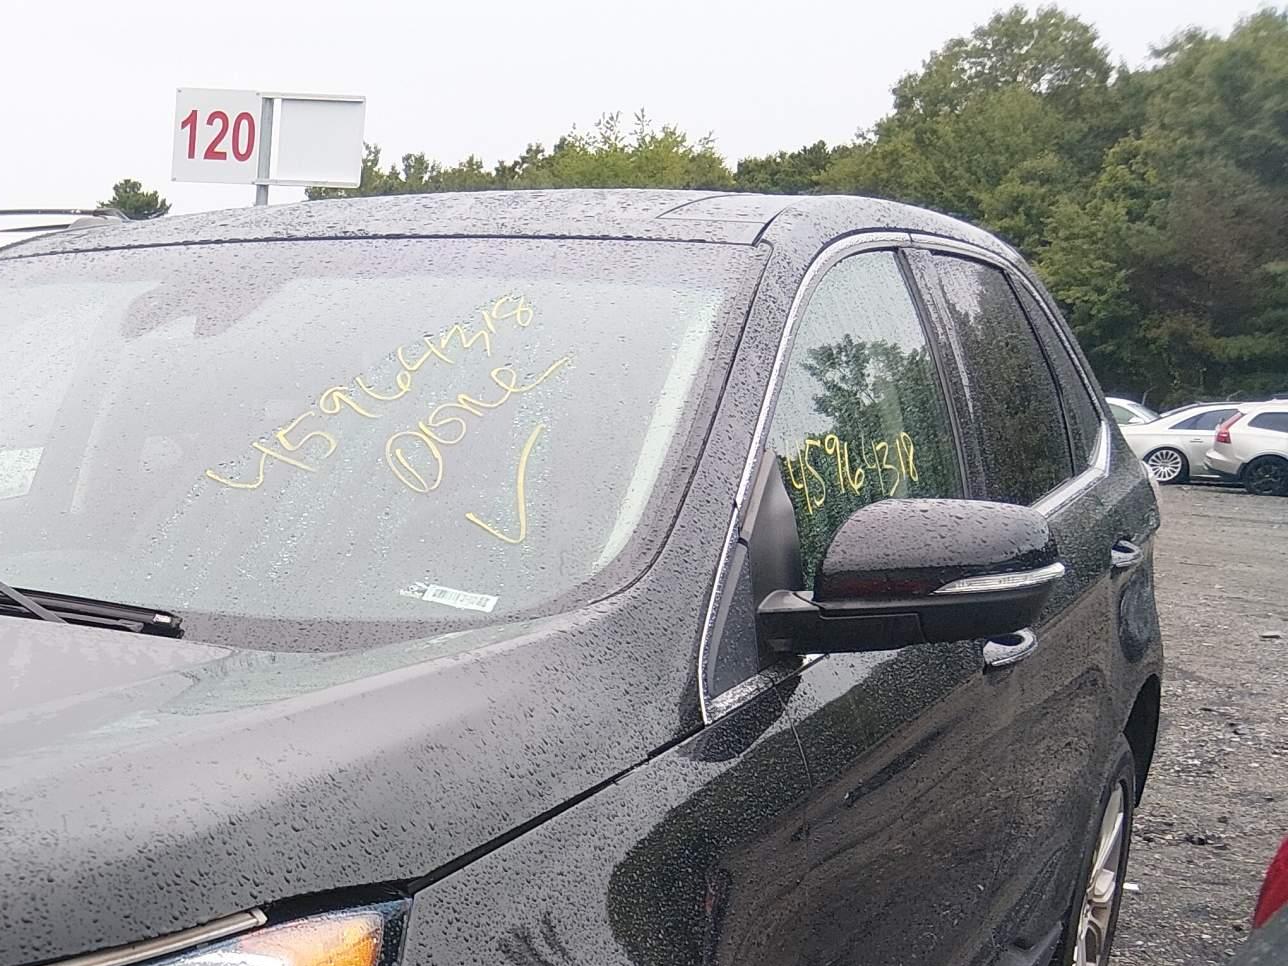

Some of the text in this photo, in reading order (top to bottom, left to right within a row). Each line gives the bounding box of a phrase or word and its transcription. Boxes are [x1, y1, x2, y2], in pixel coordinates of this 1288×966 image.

[180, 109, 256, 162] 120
[206, 295, 533, 489] 45964318
[785, 431, 919, 515] 45964318
